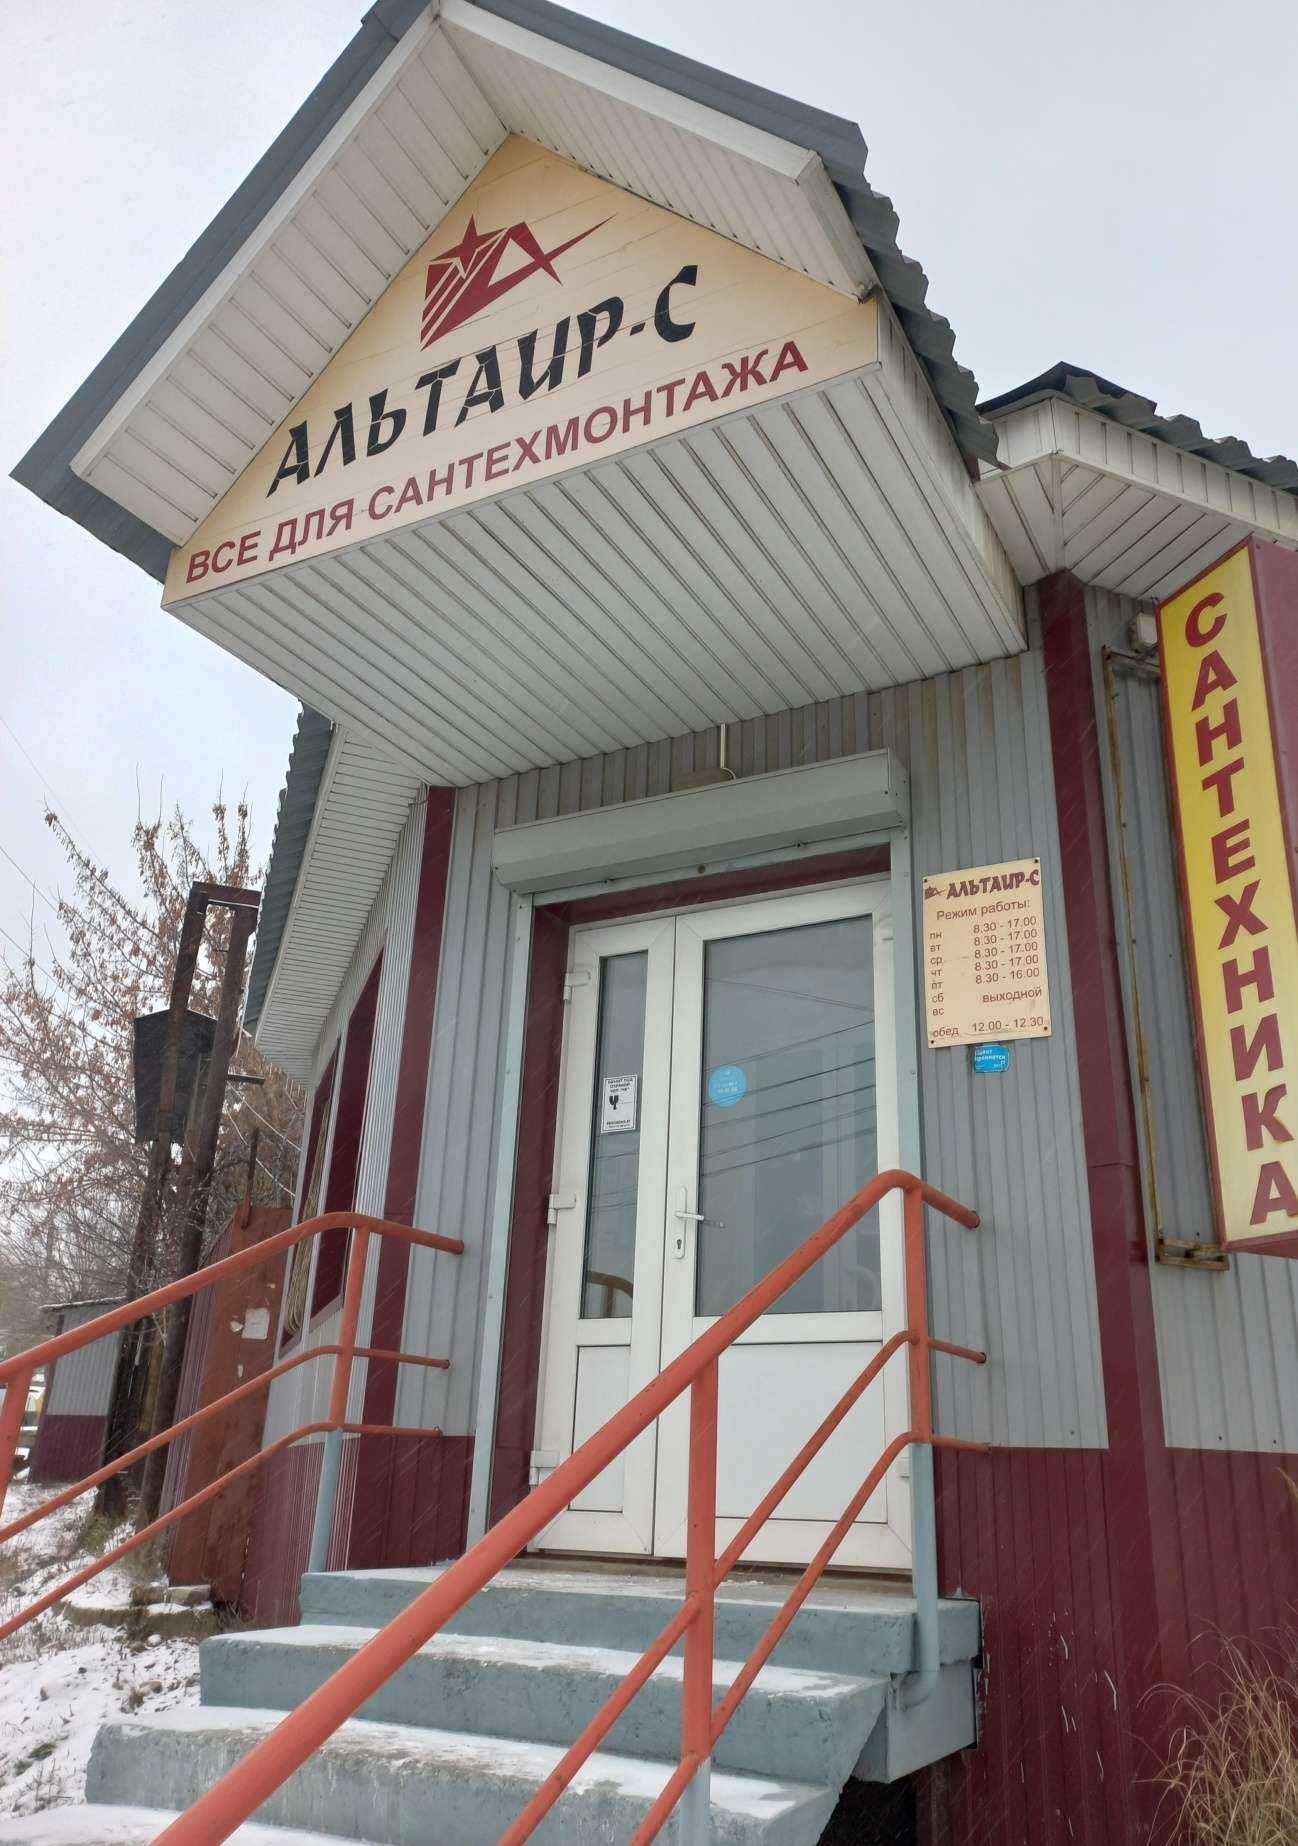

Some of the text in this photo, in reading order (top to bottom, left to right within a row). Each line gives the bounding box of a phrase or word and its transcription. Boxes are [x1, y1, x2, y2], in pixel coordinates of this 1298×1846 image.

[266, 264, 698, 498] АЛЬТАИР-С
[185, 340, 809, 584] ВСЕ ДЛЯ САНТЕХМОНТАЖА
[946, 869, 1040, 900] АЛЬТАИР-С
[936, 899, 1030, 920] Режим работы:
[1185, 592, 1298, 1226] САНТЕХНИКА
[930, 932, 942, 940] пн
[973, 922, 997, 934] 8.30
[1008, 916, 1037, 928] 17.00
[930, 944, 941, 952] вт
[974, 935, 997, 946] 8.30
[1009, 928, 1037, 941] 17.00
[930, 957, 943, 966] ср
[974, 947, 998, 959] 8.30
[1009, 941, 1038, 954] 17.00
[931, 969, 942, 977] чт
[975, 960, 998, 971] 8.30
[1010, 954, 1039, 967] 17.00
[931, 981, 943, 990] пт
[976, 973, 998, 984] 8.30
[1011, 968, 1040, 980] 16.00
[932, 992, 944, 1003] сб
[983, 987, 1042, 1003] выходной
[932, 1008, 944, 1016] вс
[933, 1027, 960, 1038] обед
[973, 1020, 1002, 1032] 12.00
[1014, 1016, 1044, 1028] 12.30
